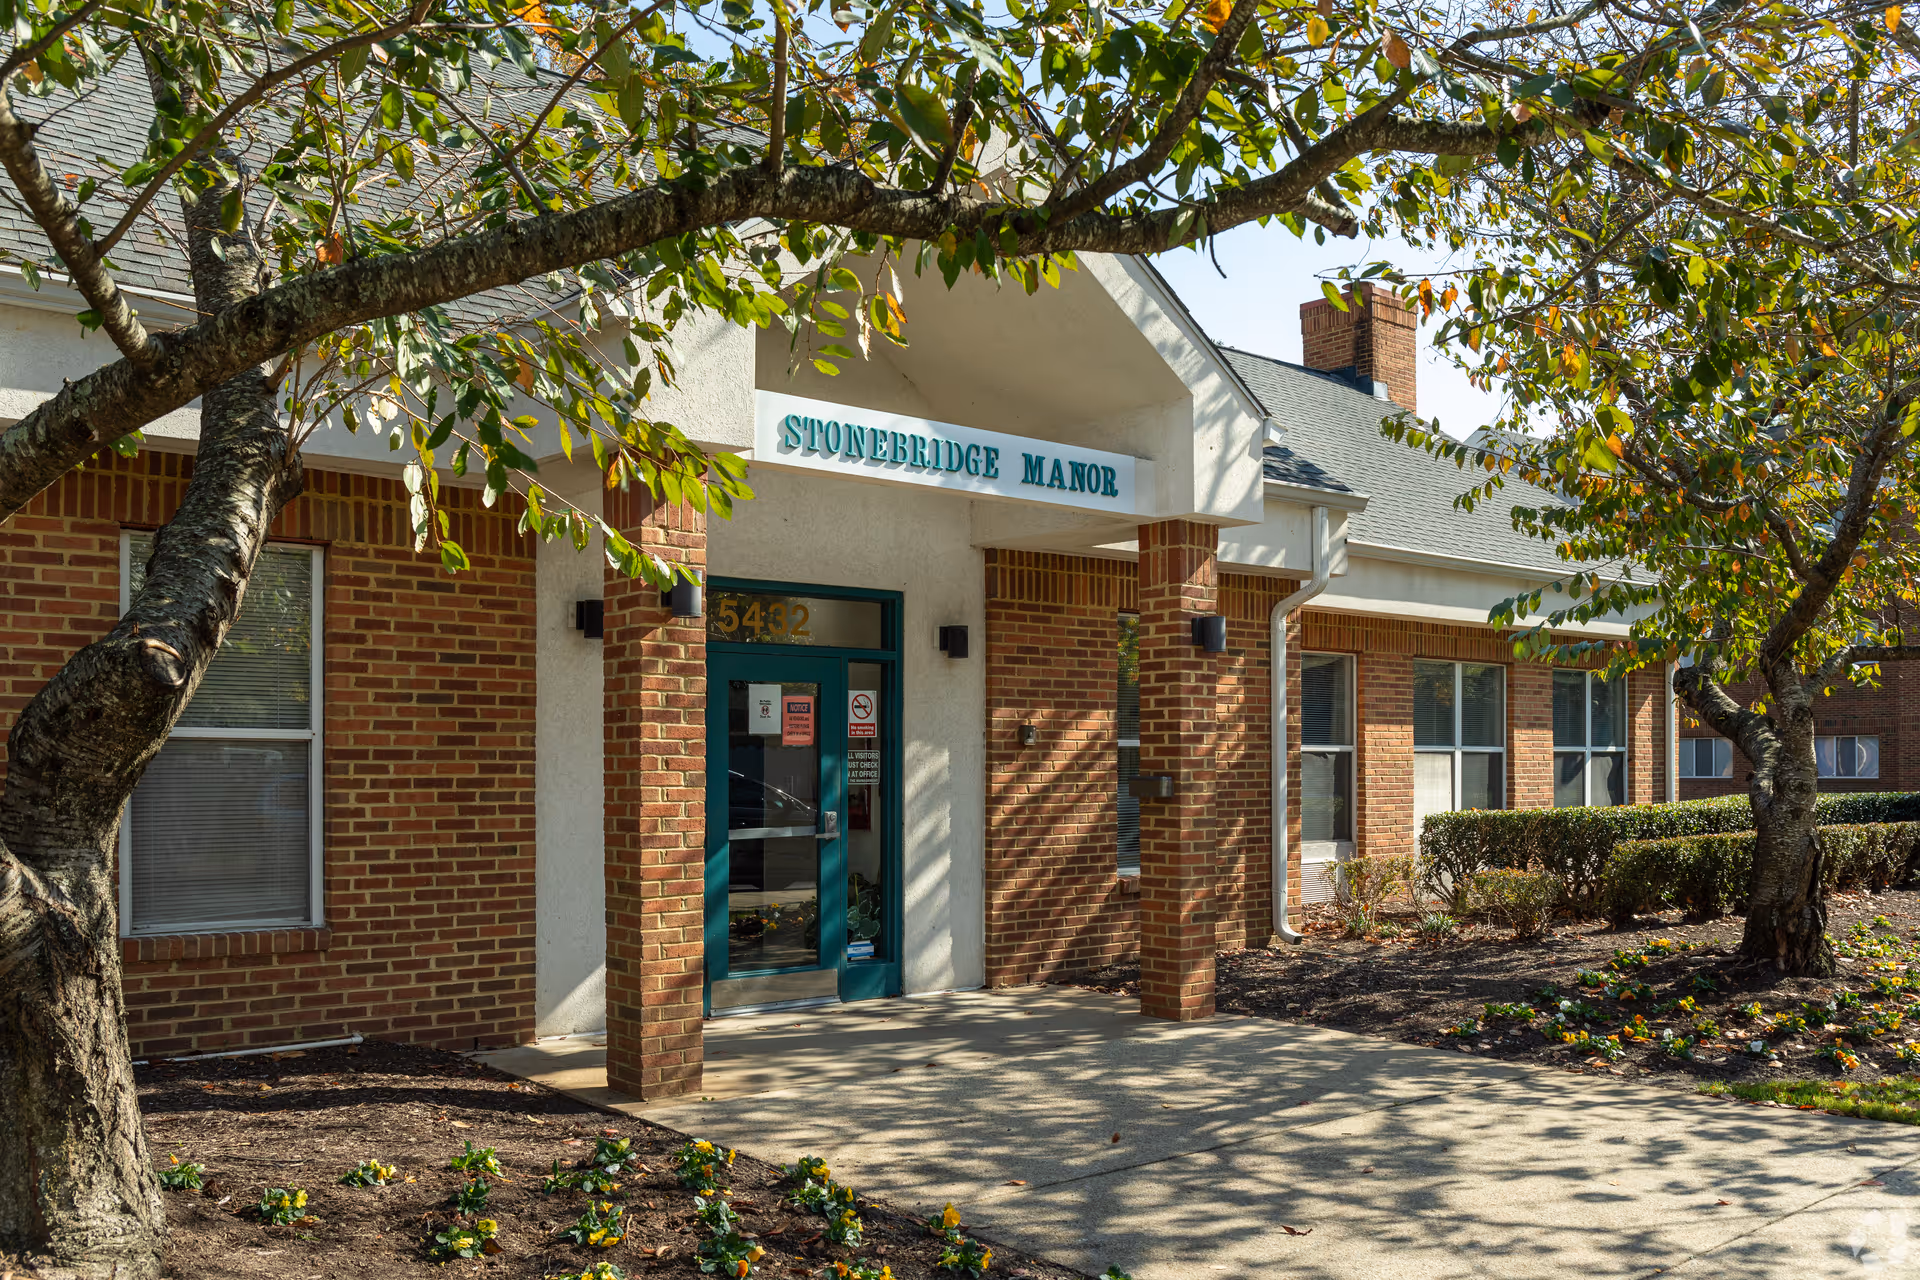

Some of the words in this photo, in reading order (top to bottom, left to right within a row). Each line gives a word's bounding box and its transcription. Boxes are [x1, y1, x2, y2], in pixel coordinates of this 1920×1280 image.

[785, 414, 999, 478] STONEBRIDGE
[1021, 453, 1119, 497] MANOR
[718, 599, 810, 637] 5432
[790, 704, 808, 712] NOTICE
